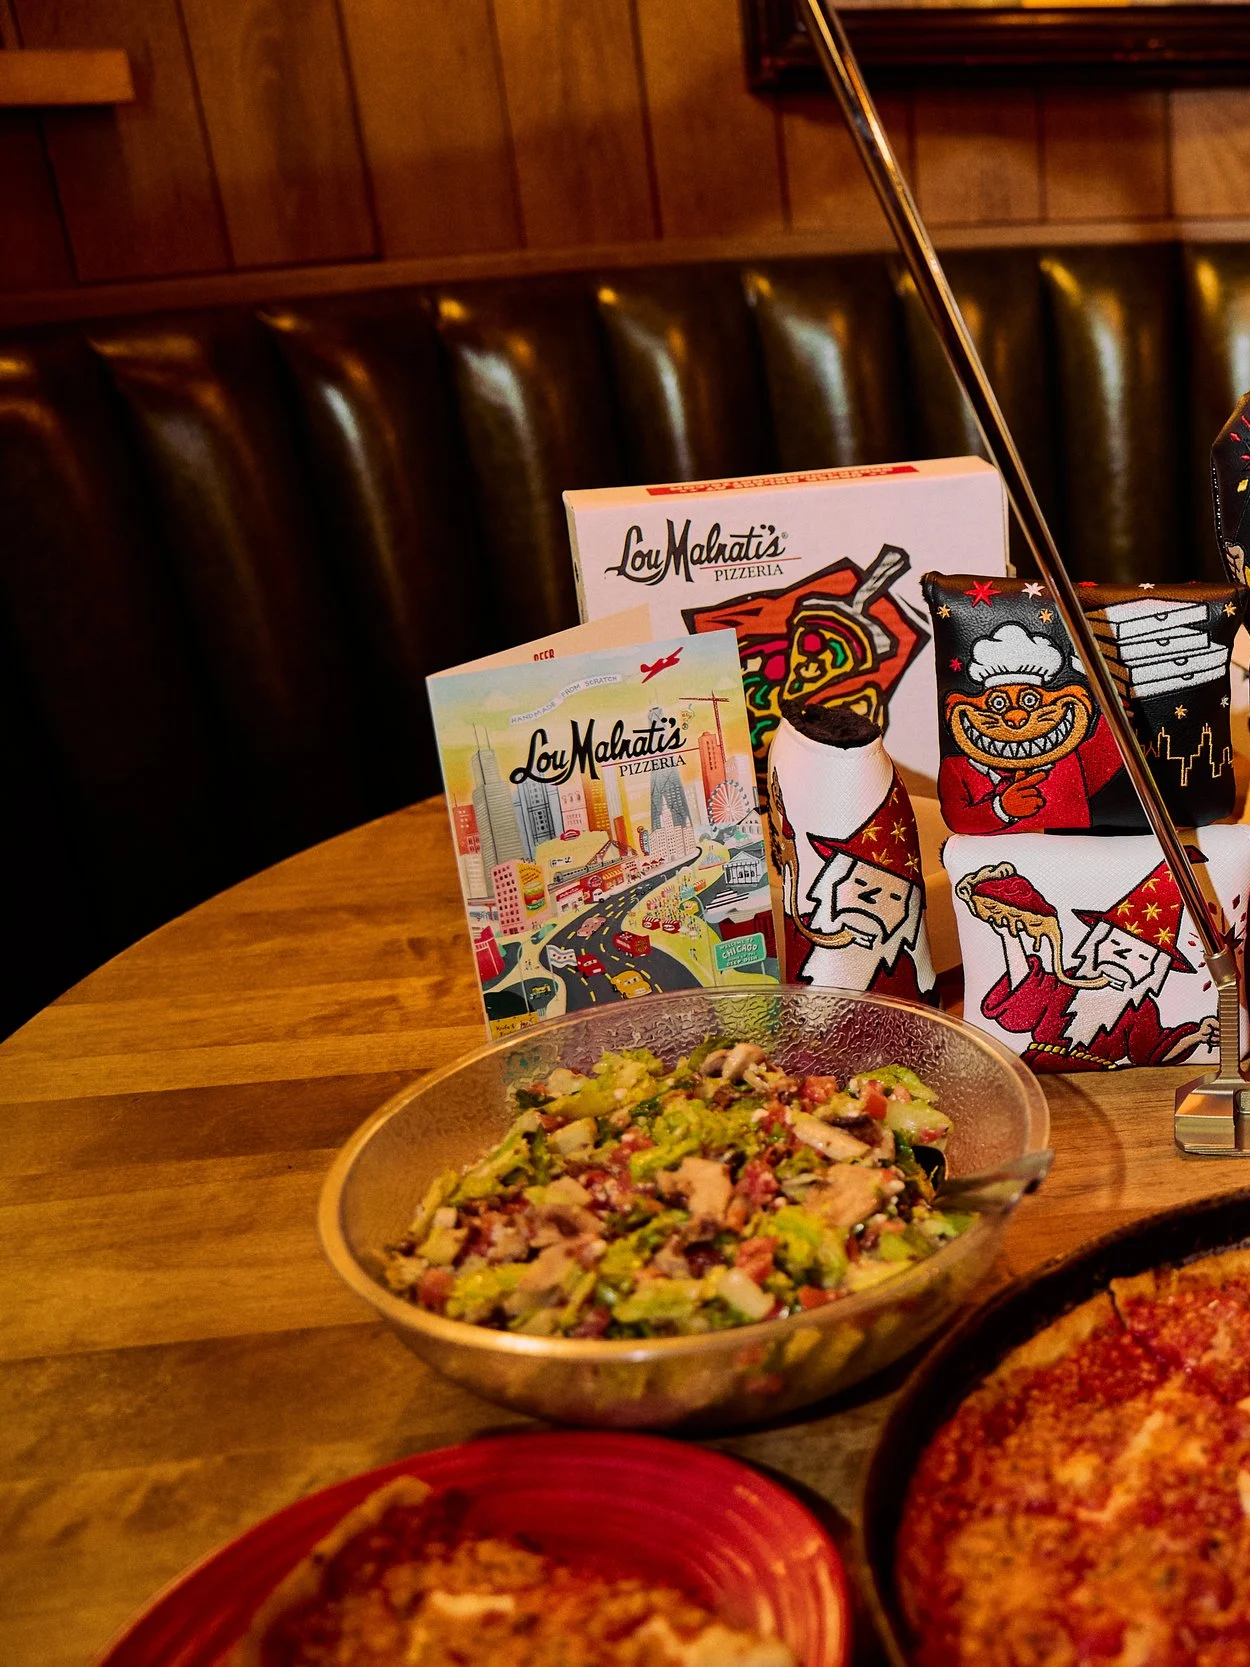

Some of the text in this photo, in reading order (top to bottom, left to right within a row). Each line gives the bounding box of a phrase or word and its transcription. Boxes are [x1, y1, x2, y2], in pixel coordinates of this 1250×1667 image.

[604, 518, 786, 585] Lou Malnati's
[714, 563, 784, 582] PIZZERIA
[510, 675, 618, 724] HANDMADE FROM SCRATCH
[509, 717, 688, 785] Lou Malnati's
[619, 755, 687, 777] PIZZERIA
[722, 944, 758, 959] CHICAGO
